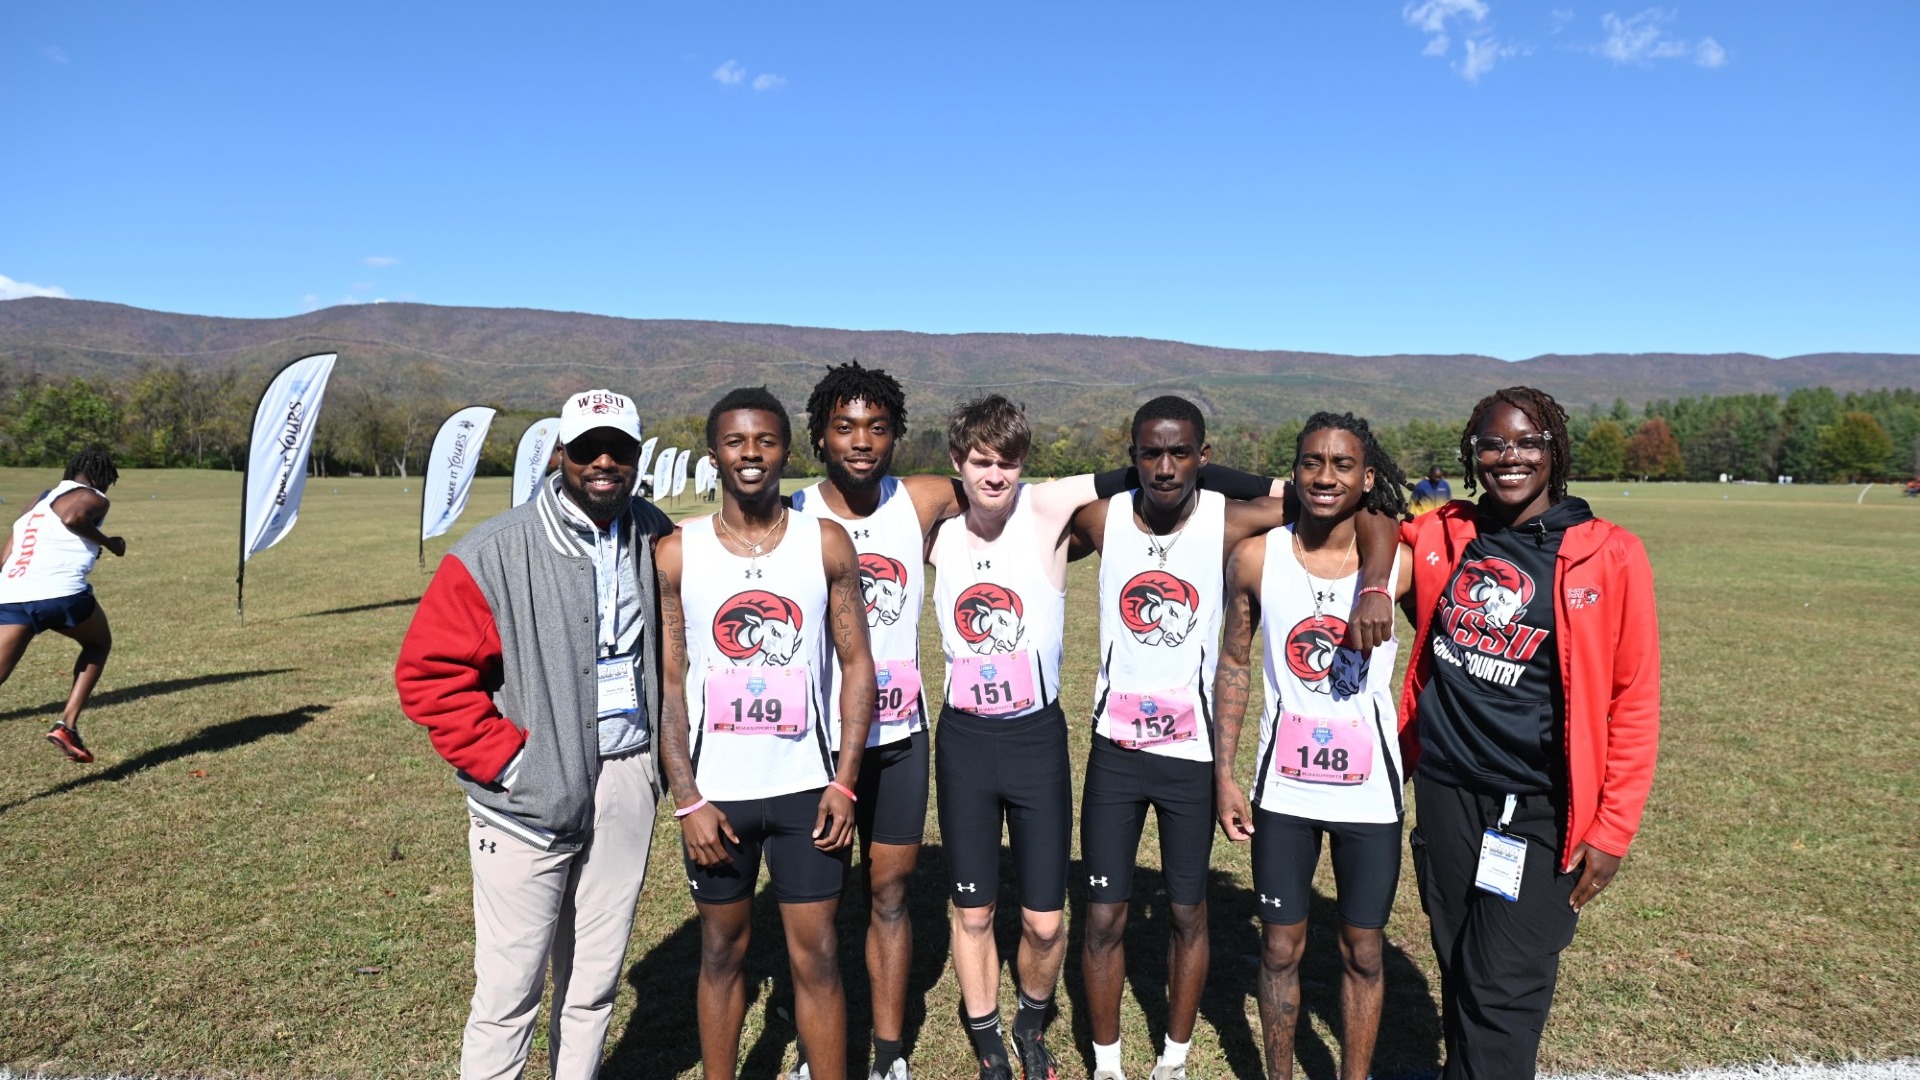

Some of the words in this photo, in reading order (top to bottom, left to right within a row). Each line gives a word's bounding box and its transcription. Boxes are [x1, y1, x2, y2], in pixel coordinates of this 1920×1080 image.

[578, 393, 624, 408] WSSU
[278, 400, 304, 456] YOURS
[284, 456, 293, 472] IT
[447, 433, 468, 469] YOURS
[529, 439, 544, 467] YOURS
[450, 469, 458, 479] IT
[446, 479, 457, 507] MAKE
[8, 513, 45, 578] LIONS
[835, 562, 851, 655] LOYALTY
[1438, 596, 1550, 662] WSSU
[1433, 634, 1465, 667] CROSS
[1464, 651, 1526, 687] COUNTRY
[874, 688, 903, 711] 50
[970, 681, 1012, 705] 151
[731, 698, 782, 722] 149
[1131, 714, 1176, 739] 152
[1297, 745, 1349, 771] 148
